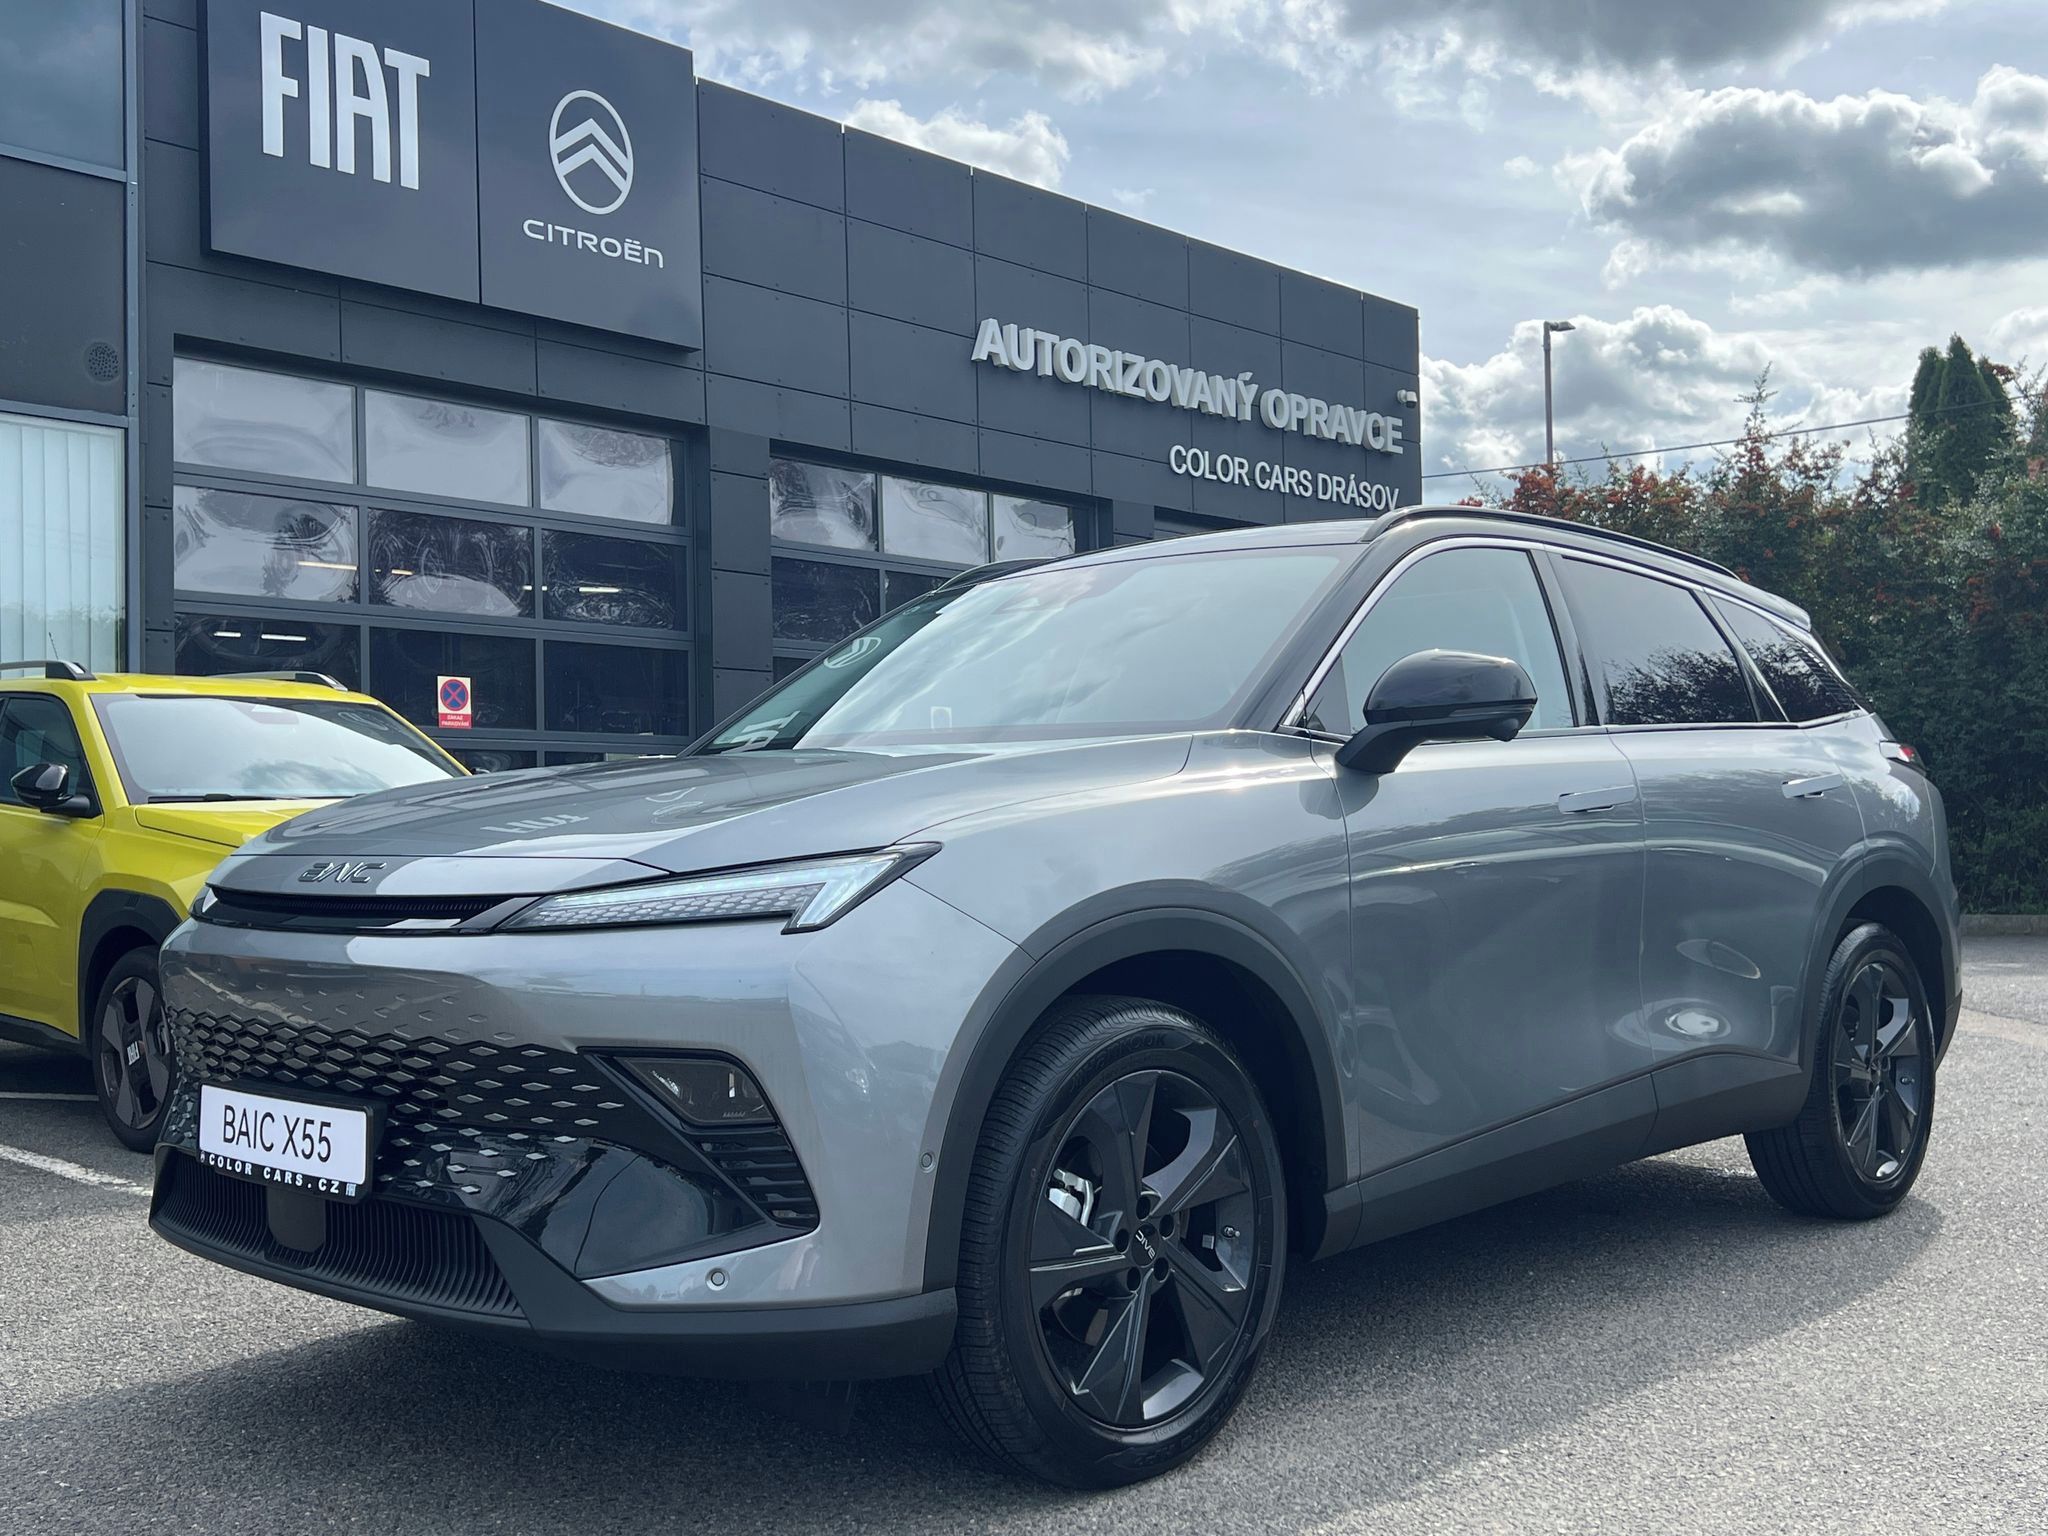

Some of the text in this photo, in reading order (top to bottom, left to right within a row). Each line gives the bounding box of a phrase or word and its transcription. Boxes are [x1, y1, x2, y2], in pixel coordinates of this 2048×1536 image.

[260, 11, 430, 191] FIAT
[522, 219, 664, 269] CITROËN
[970, 317, 1403, 454] AUTORIZOVANÝ OPRAVCE
[1169, 444, 1400, 511] COLOR CARS DRÁSOV
[223, 1104, 332, 1163] BAIC X55
[208, 1153, 252, 1176] COLOR
[263, 1166, 339, 1194] CARS.CZ
